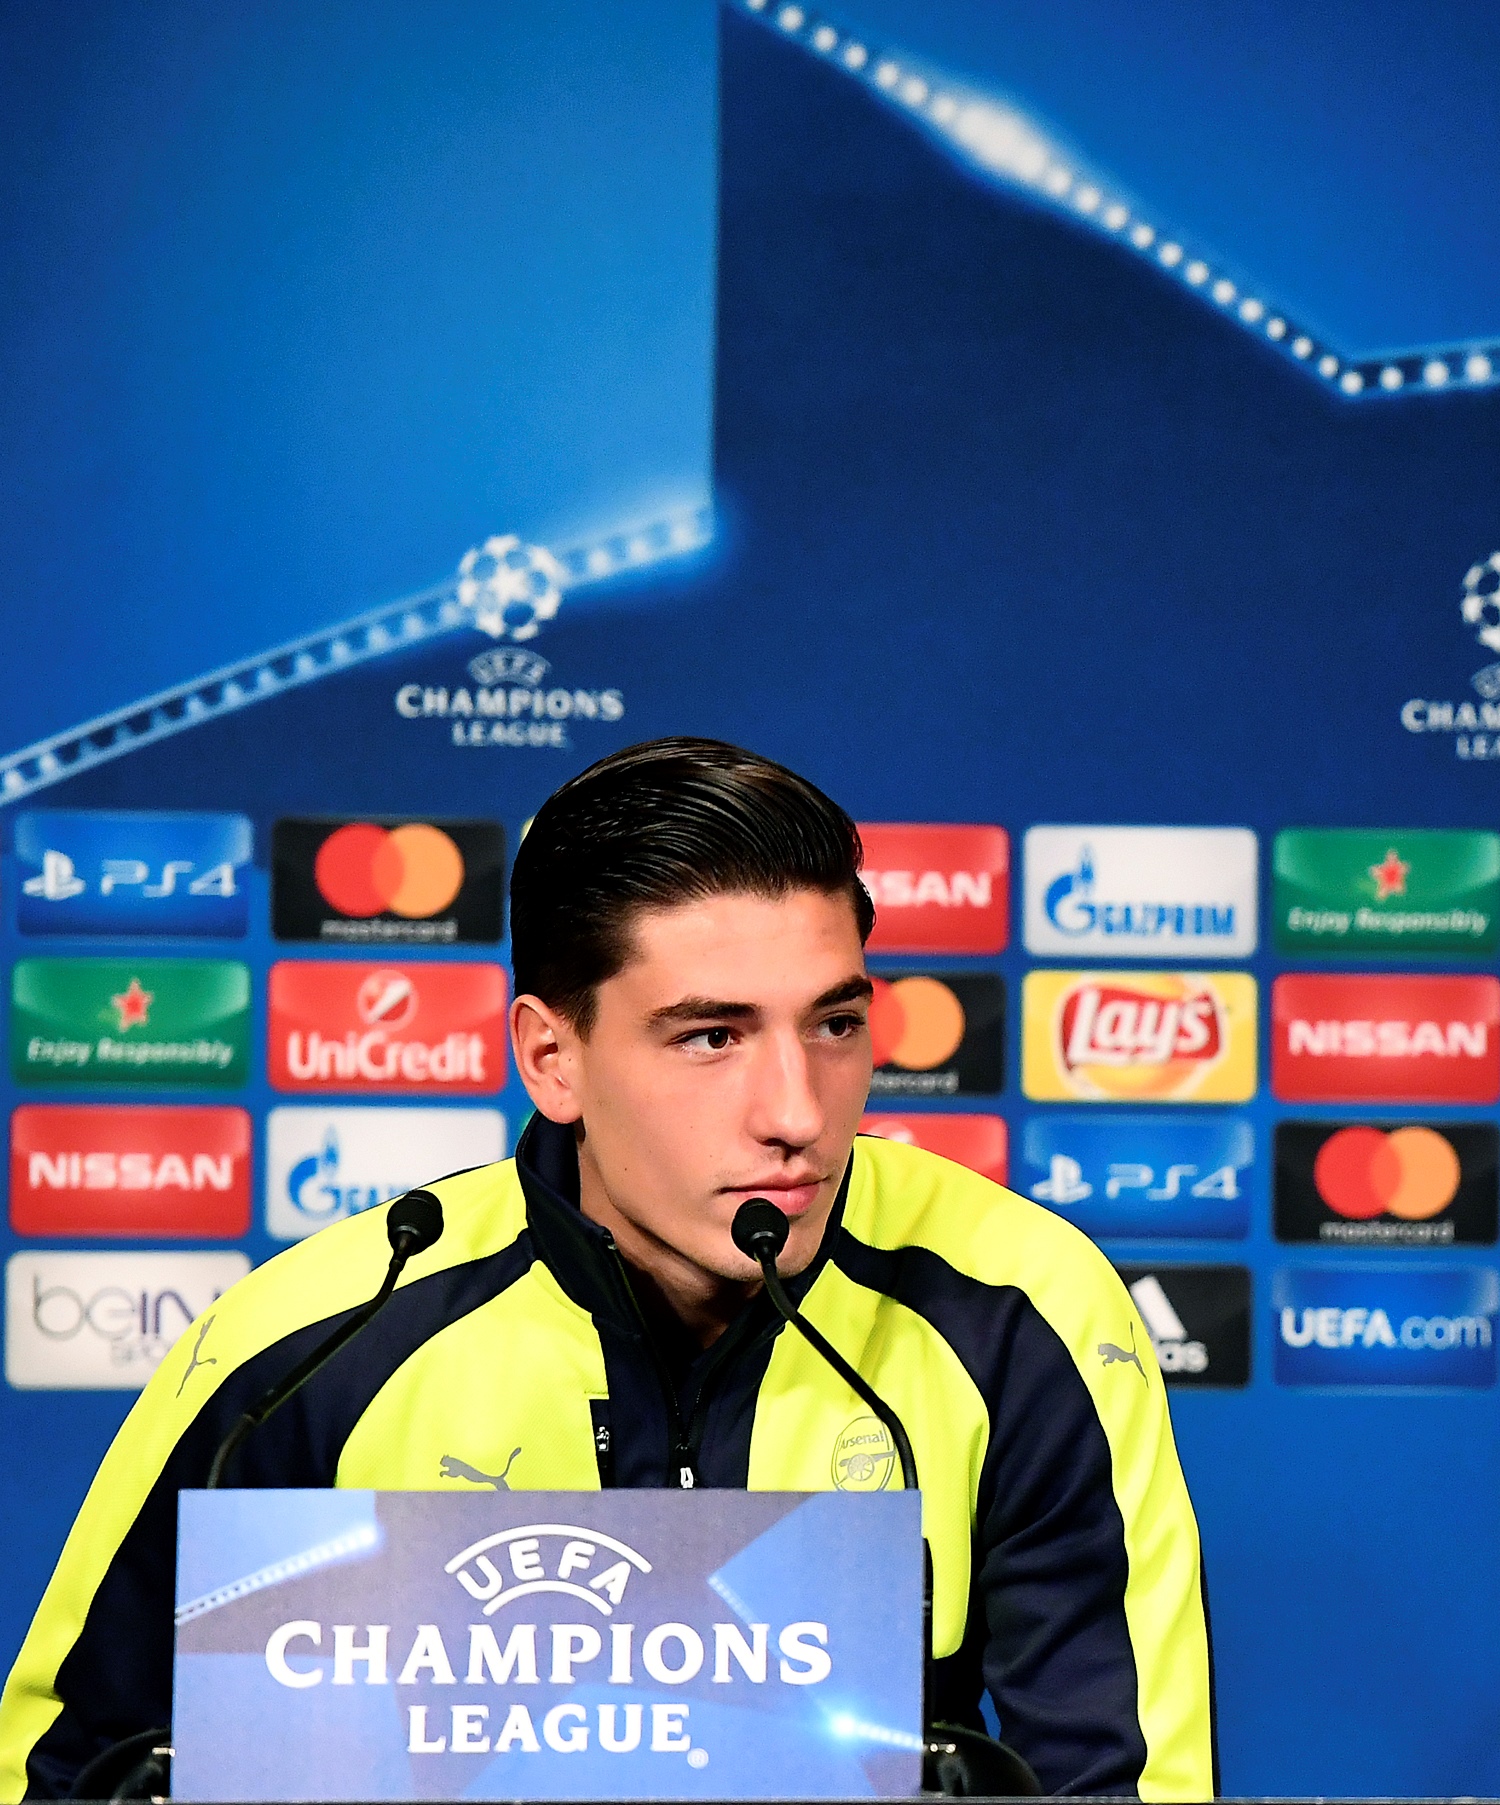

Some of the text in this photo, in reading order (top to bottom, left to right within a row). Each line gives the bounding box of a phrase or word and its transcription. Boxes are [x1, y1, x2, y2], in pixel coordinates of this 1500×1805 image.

[396, 684, 625, 721] CHAMPIONS
[452, 721, 567, 747] LEAGUE
[101, 859, 236, 898] PS4
[1288, 906, 1349, 935] Enjoy
[27, 1036, 91, 1066] Enjoy
[287, 1030, 485, 1082] UniCredit
[1288, 1020, 1487, 1058] NISSAN
[28, 1152, 233, 1191] NISSAN
[1106, 1163, 1241, 1201] PS4
[1280, 1306, 1493, 1350] UEFA.com
[839, 1429, 885, 1451] Arsenal
[454, 1539, 632, 1606] UEFA
[264, 1620, 833, 1690] CHAMPIONS
[406, 1702, 693, 1755] LEAGUE
